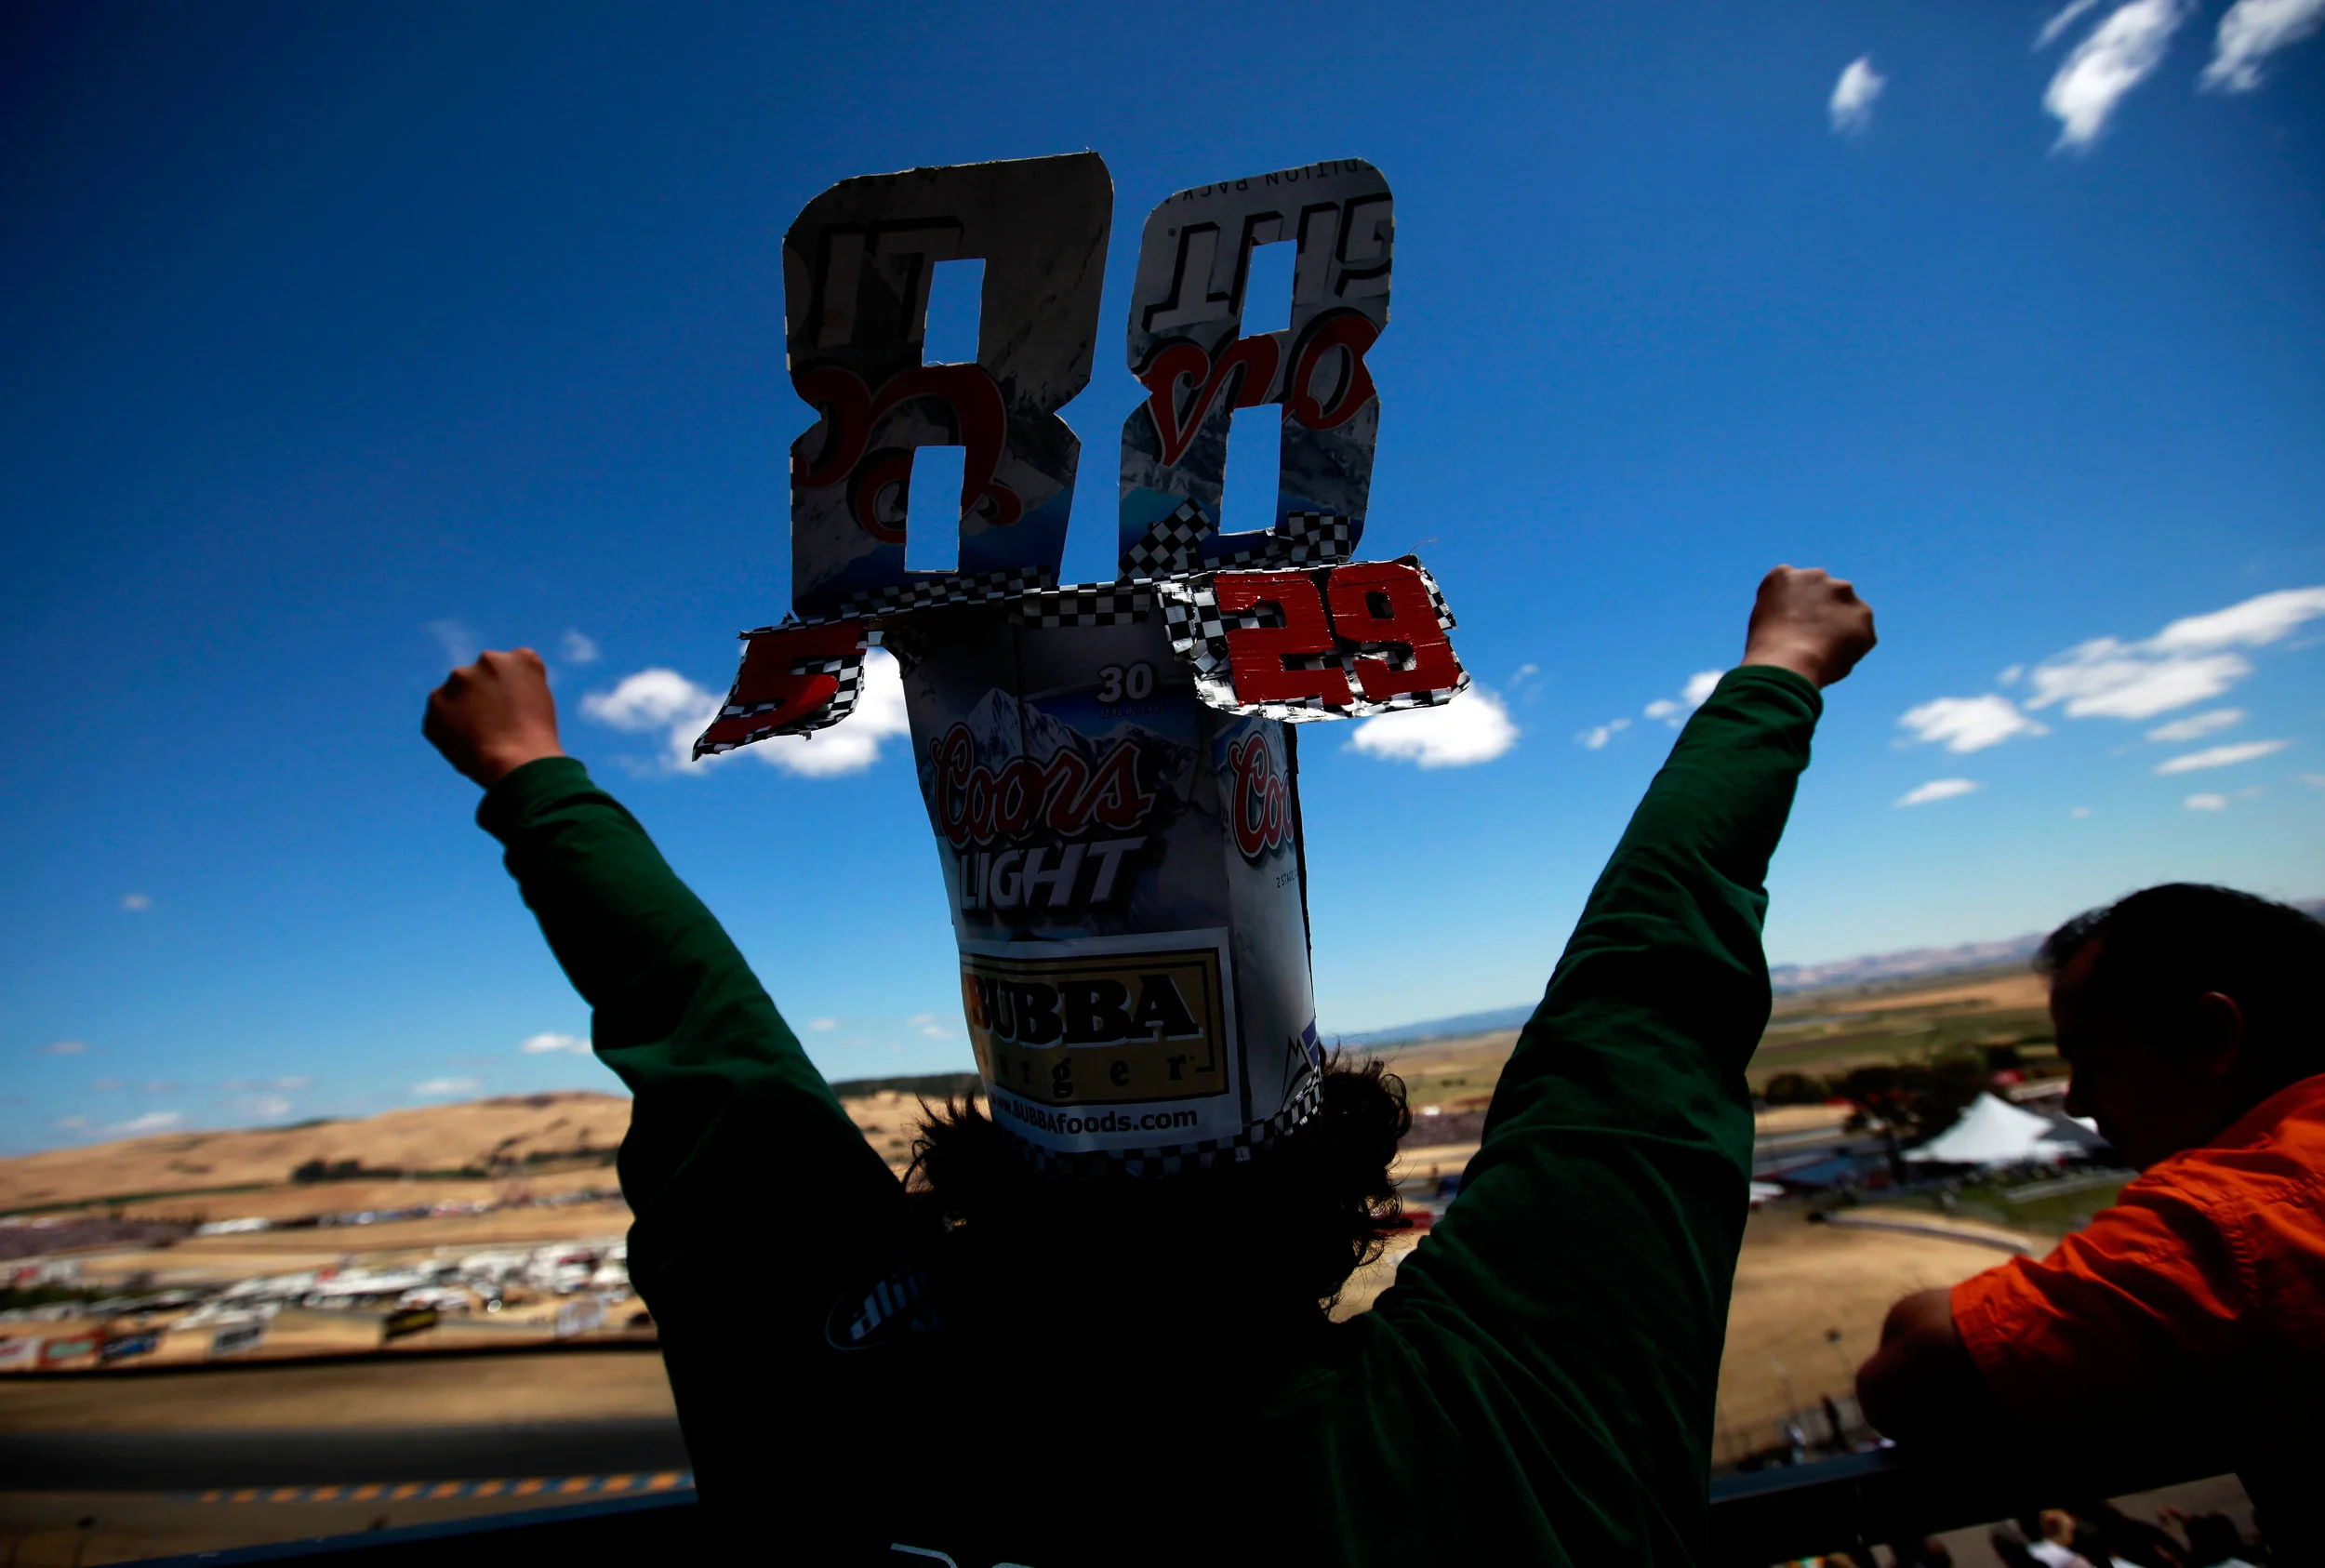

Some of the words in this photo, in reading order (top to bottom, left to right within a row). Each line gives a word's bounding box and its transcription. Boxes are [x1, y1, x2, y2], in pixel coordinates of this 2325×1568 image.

[1164, 179, 1247, 204] PACK
[1213, 560, 1462, 707] 29
[704, 618, 869, 744] 5
[1096, 662, 1154, 703] 30
[931, 721, 1156, 849] Coors
[961, 836, 1149, 911] LIGHT
[964, 974, 1203, 1048] BUBBA
[990, 1091, 1198, 1135] www.BUBBAfoods.com
